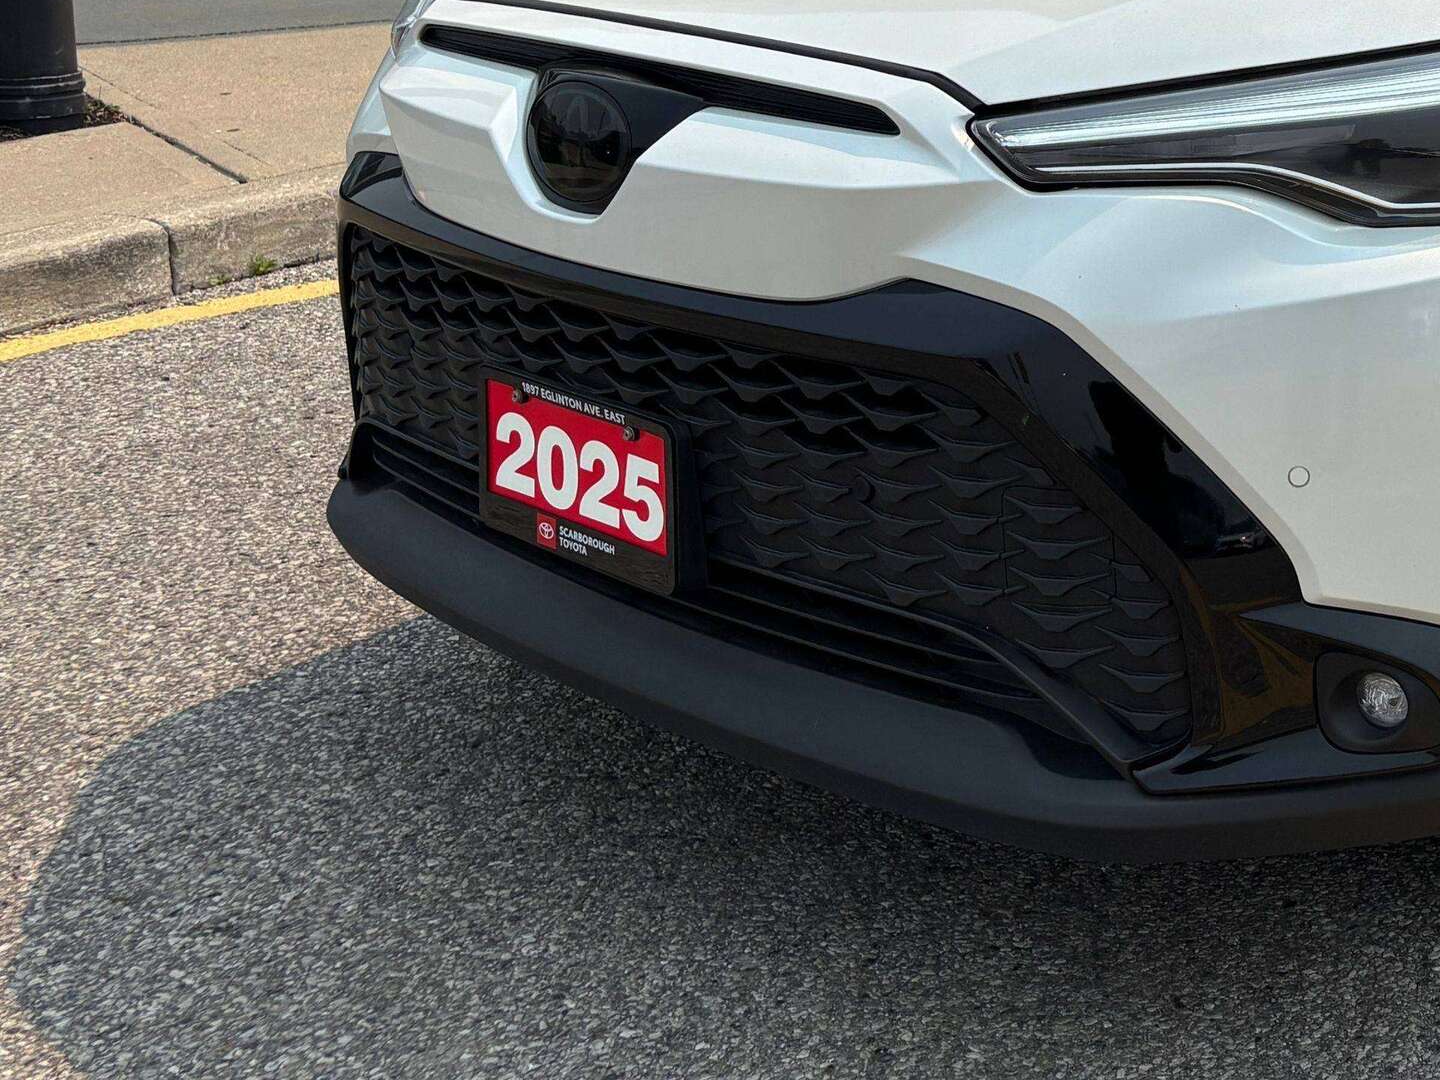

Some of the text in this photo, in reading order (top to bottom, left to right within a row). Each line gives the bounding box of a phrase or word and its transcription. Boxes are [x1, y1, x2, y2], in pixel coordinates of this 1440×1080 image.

[521, 381, 625, 425] 1897 EGLINTON AVE. EAST
[495, 411, 664, 542] 2025
[559, 525, 615, 556] SCARBOROUGH
[559, 536, 588, 556] TOYOTA
